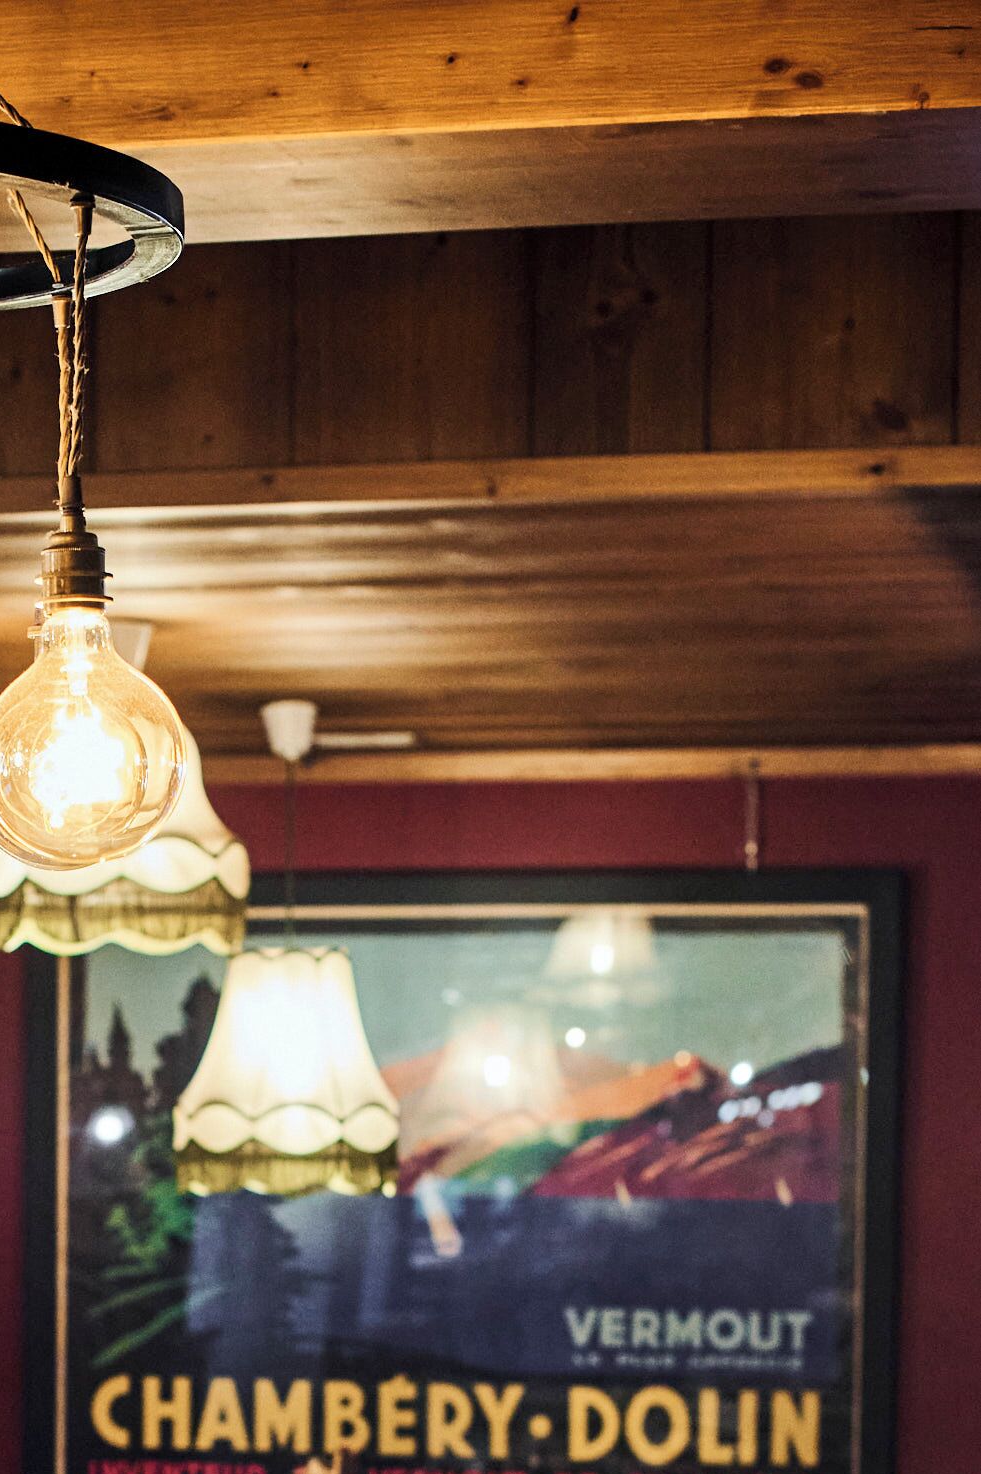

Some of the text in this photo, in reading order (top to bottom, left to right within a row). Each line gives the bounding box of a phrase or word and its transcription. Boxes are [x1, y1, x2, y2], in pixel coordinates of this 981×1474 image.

[564, 1308, 813, 1351] VERMOUT
[90, 1374, 524, 1459] CHAMBÉRY
[567, 1385, 820, 1466] DOLIN
